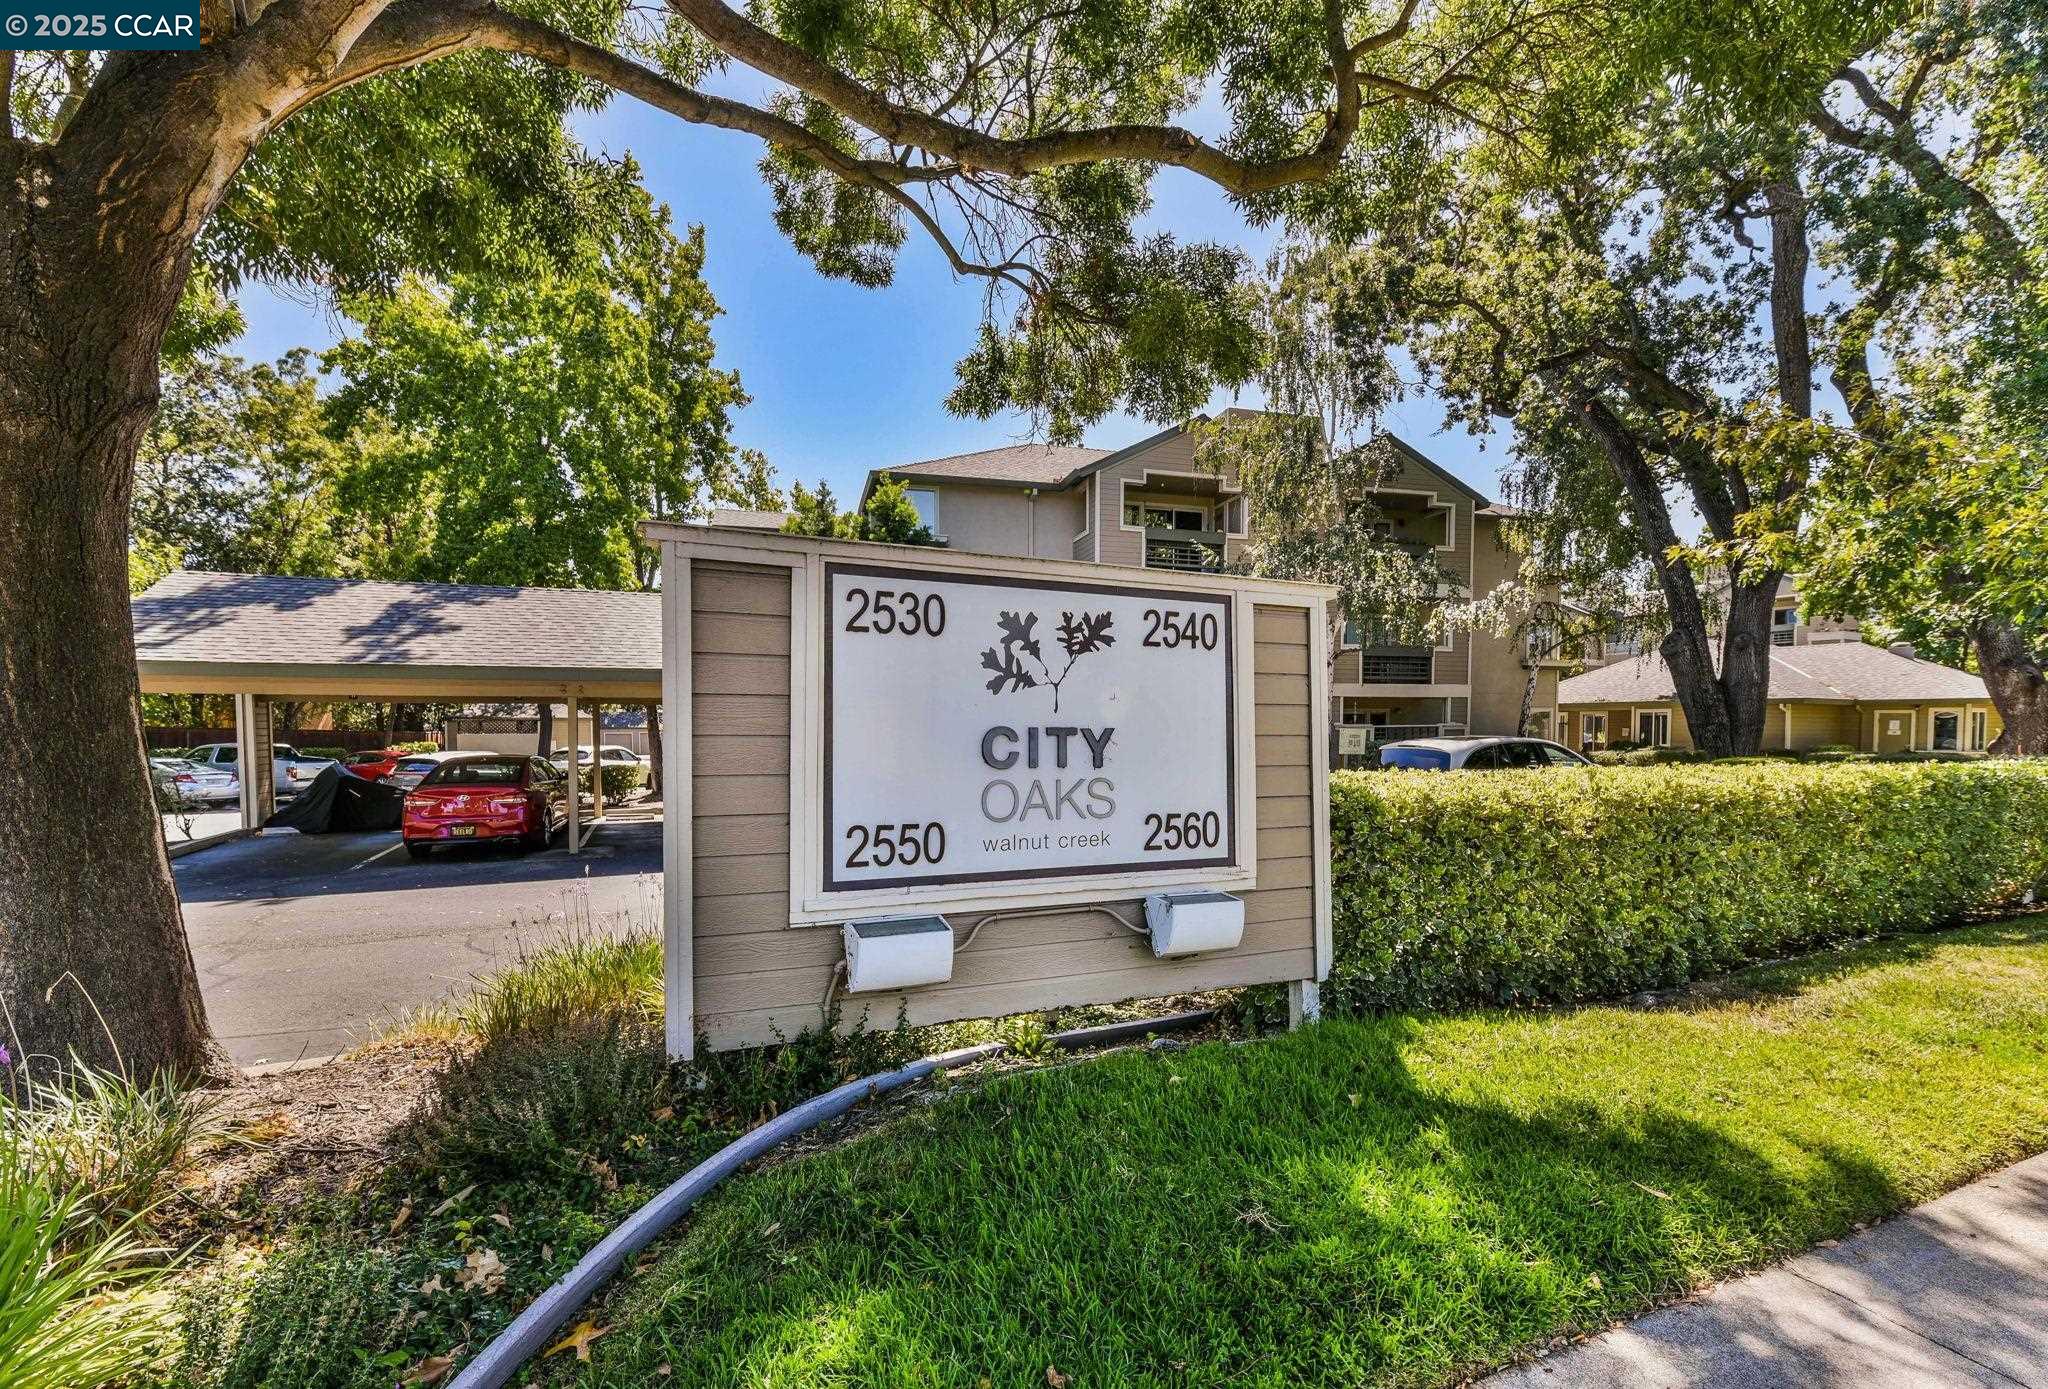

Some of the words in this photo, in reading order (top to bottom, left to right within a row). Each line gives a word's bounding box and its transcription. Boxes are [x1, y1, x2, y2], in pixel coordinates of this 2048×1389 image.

[845, 588, 946, 637] 2530
[1143, 610, 1218, 651] 2540
[981, 726, 1115, 769] CITY
[981, 777, 1115, 823] OAKS
[846, 822, 946, 868] 2550
[982, 833, 1050, 853] walnut
[1058, 830, 1112, 849] creek
[1144, 811, 1220, 851] 2560
